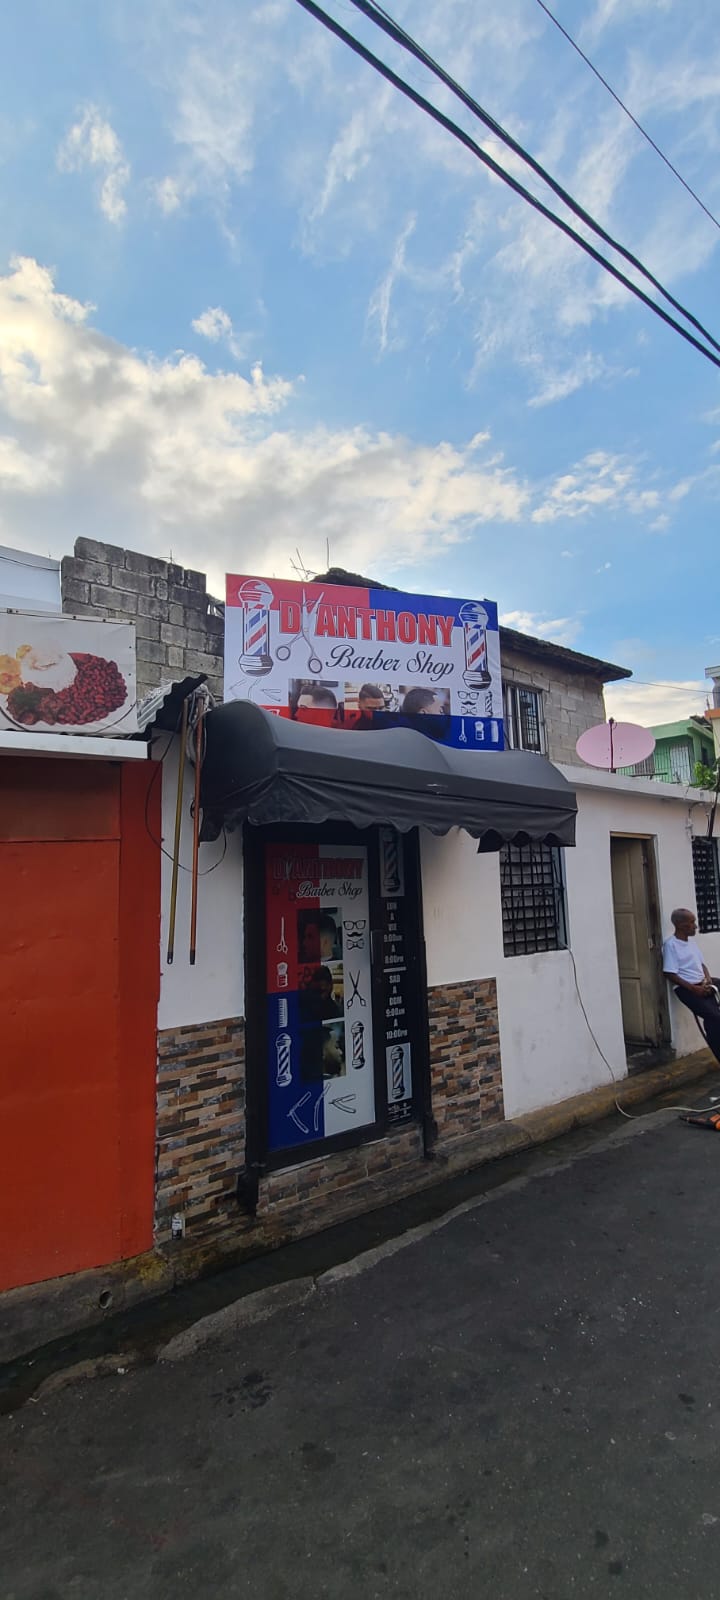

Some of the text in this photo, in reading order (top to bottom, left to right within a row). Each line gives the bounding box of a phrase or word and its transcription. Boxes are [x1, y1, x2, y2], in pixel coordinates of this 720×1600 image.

[326, 645, 454, 682] Barber Shop
[296, 881, 363, 899] Barber Shop
[390, 912, 395, 920] A
[391, 944, 396, 952] A
[392, 985, 397, 994] A
[393, 1018, 398, 1027] A
